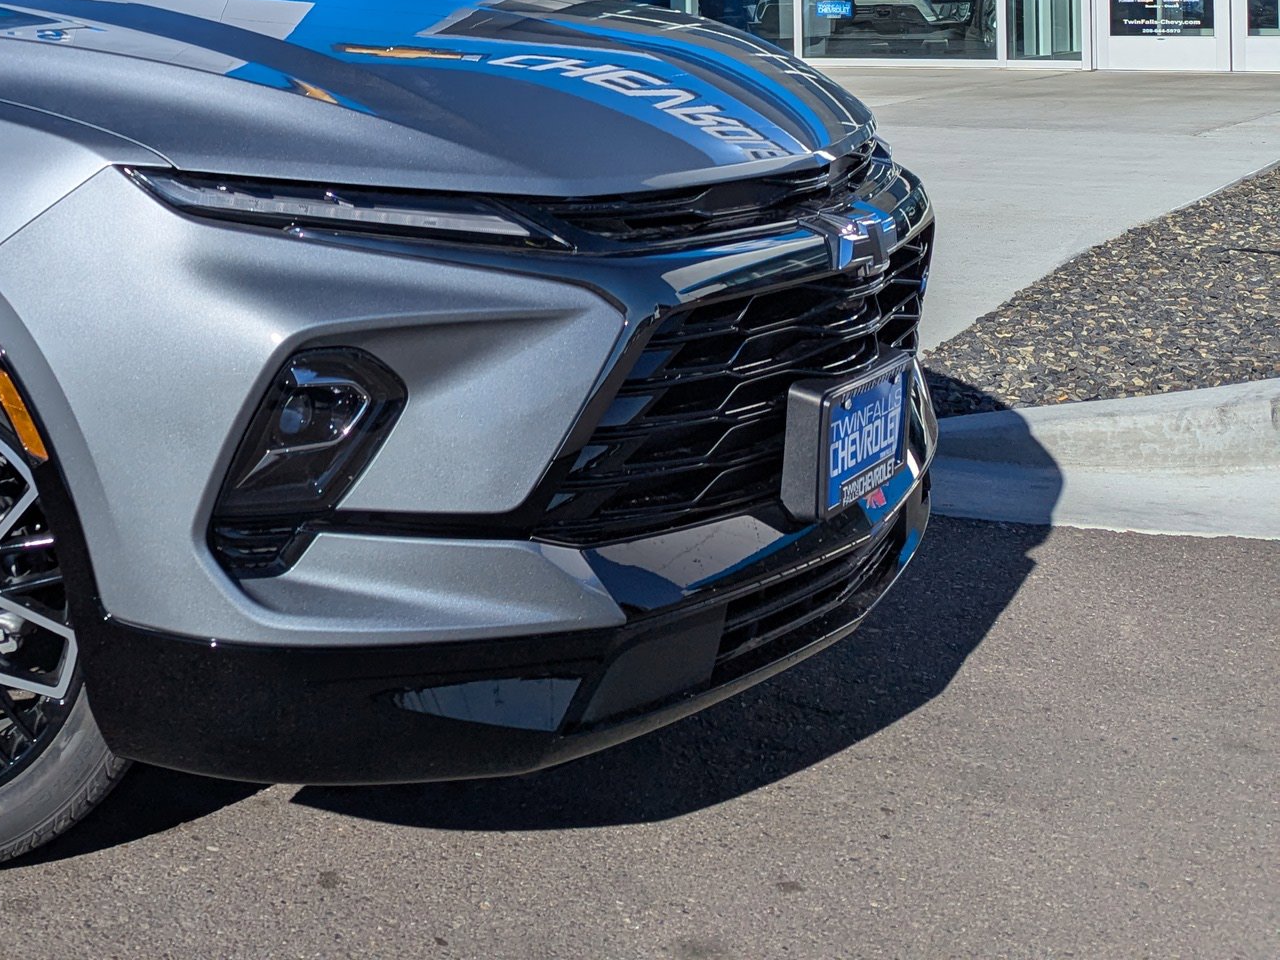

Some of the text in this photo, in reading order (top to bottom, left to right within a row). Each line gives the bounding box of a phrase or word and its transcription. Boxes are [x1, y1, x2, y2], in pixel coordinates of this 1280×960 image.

[831, 388, 902, 441] TWINFALLS
[830, 407, 901, 478] CHEVROLET
[859, 457, 895, 496] CHEVROLET
